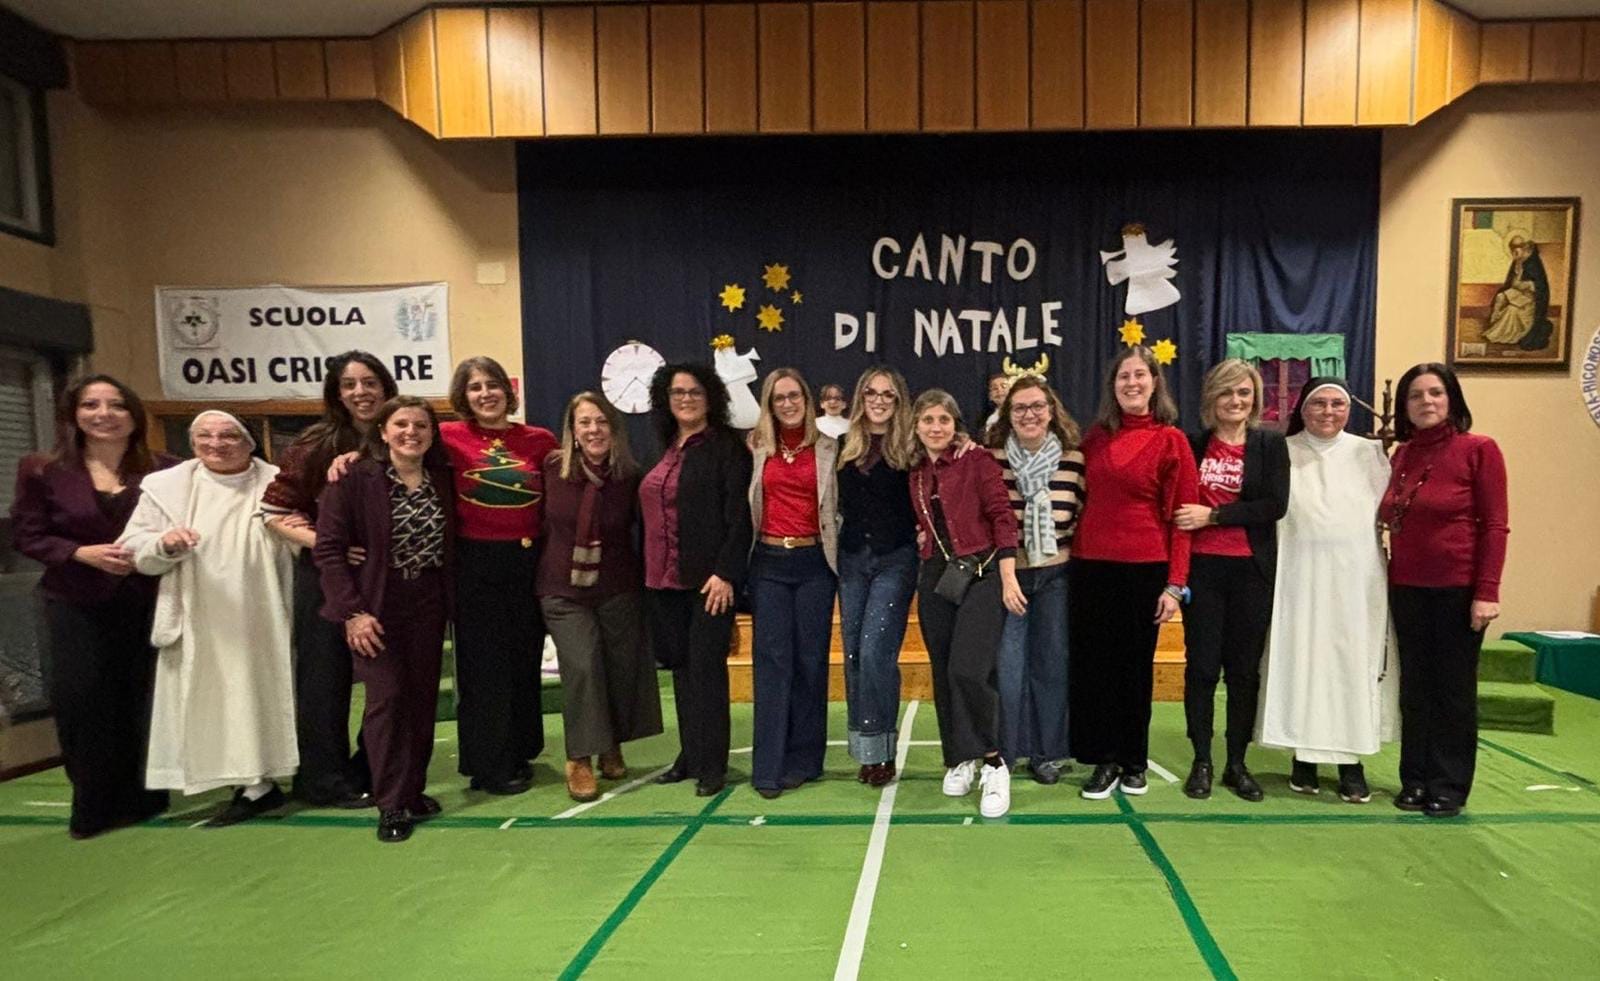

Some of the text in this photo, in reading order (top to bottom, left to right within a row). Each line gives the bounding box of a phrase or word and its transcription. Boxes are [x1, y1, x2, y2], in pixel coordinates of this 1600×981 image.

[872, 232, 1036, 285] CANTO
[250, 306, 366, 327] SCUOLA
[834, 301, 1063, 358] DI NATALE
[182, 357, 257, 384] OASI
[268, 356, 337, 384] CRI
